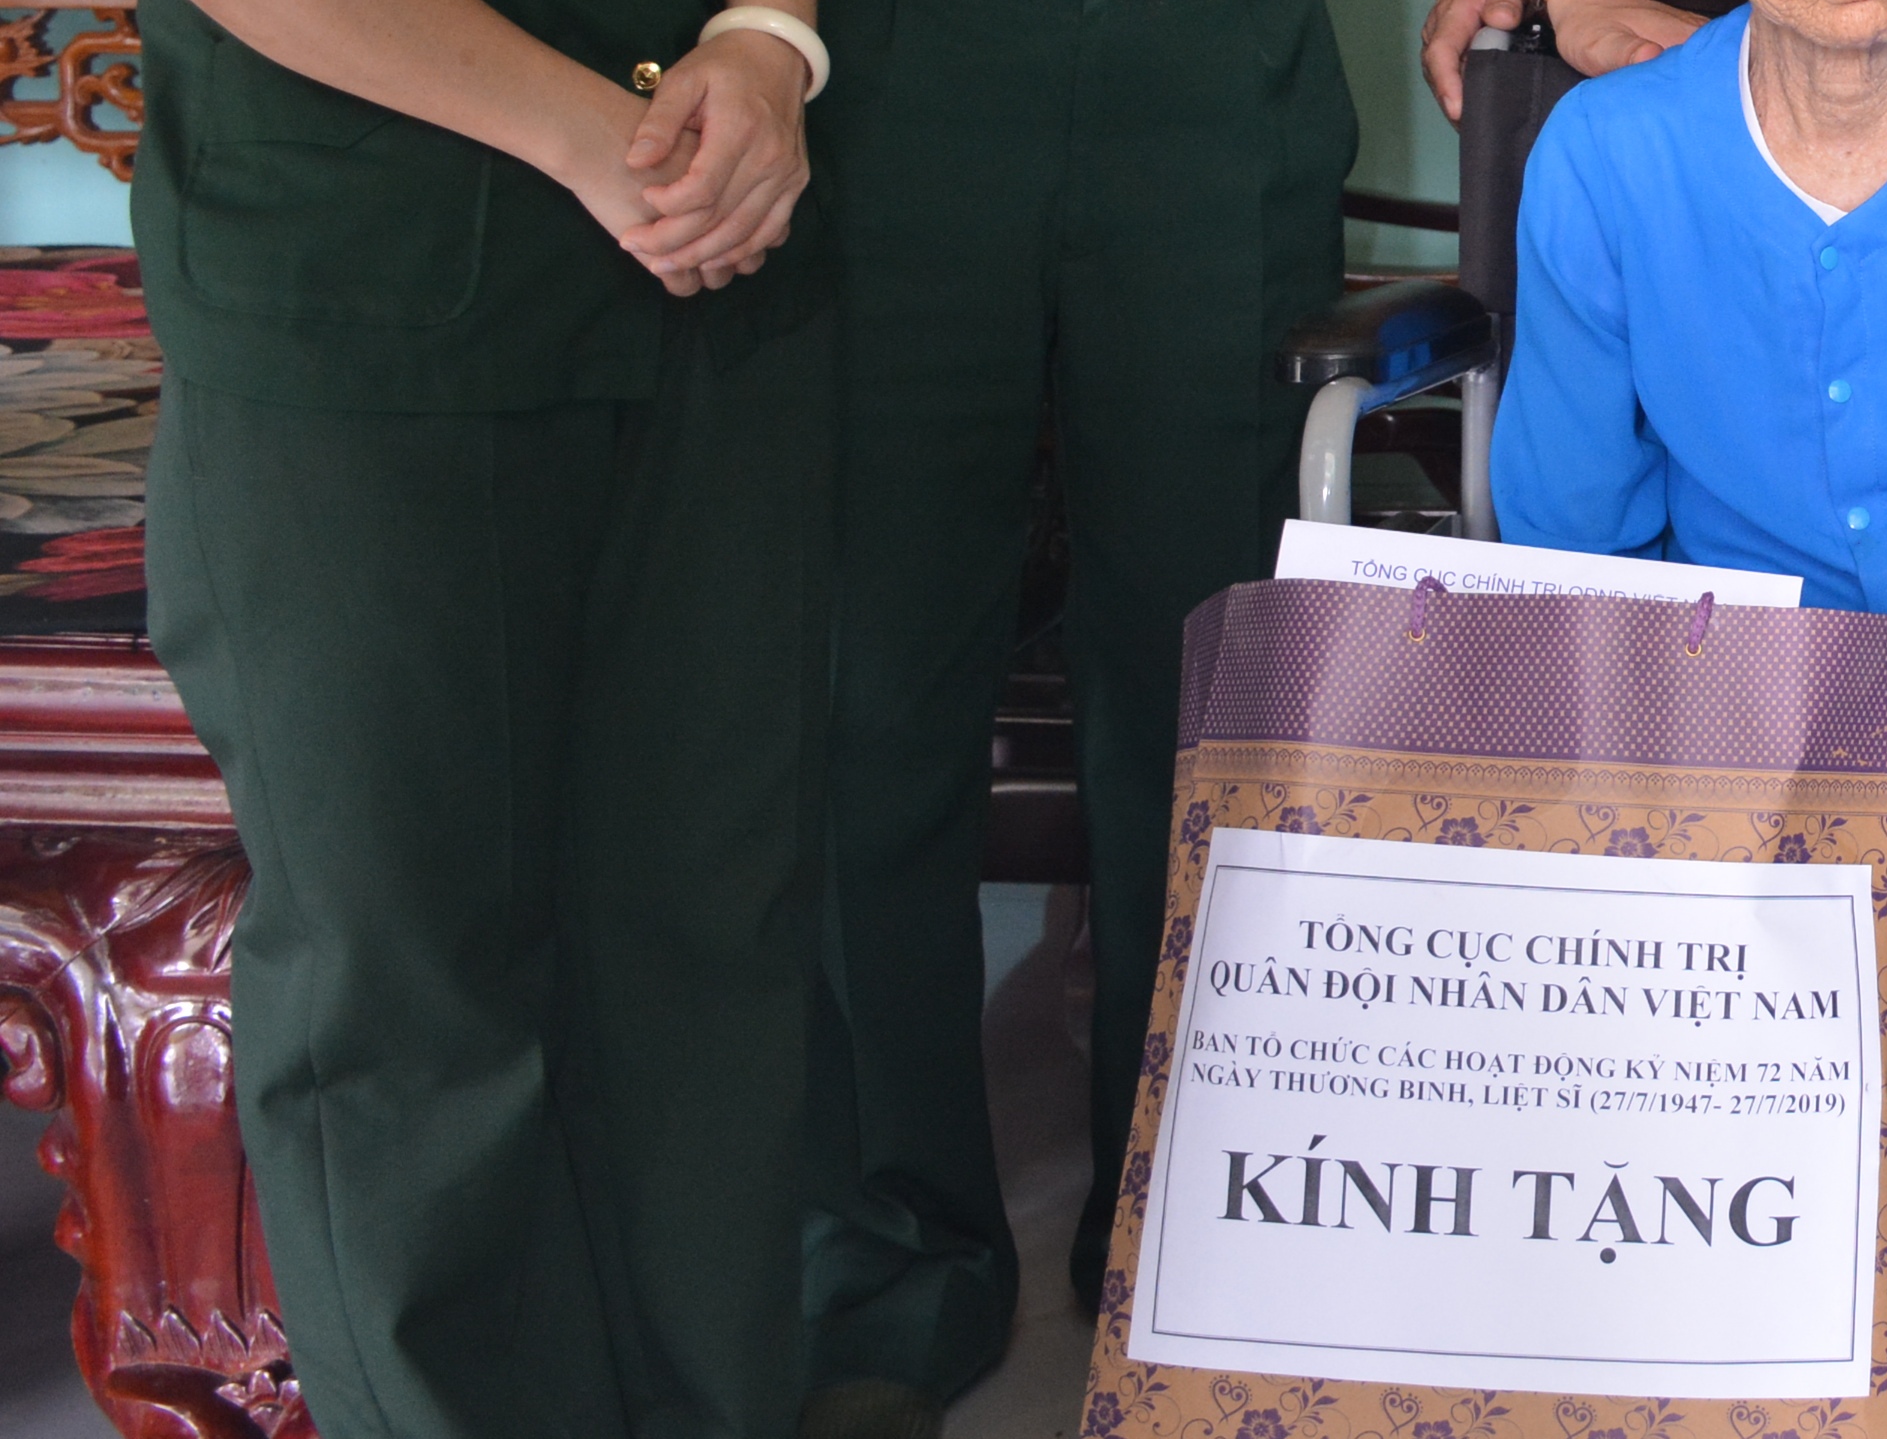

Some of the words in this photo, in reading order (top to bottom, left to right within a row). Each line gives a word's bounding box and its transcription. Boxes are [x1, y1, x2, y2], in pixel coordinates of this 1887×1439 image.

[1351, 559, 1408, 581] TỔNG
[1462, 573, 1525, 594] CHÍNH
[1299, 913, 1414, 956] TỔNG
[1427, 928, 1513, 968] CỤC
[1526, 929, 1663, 969] CHÍNH
[1678, 942, 1749, 981] TRỊ
[1210, 956, 1312, 997] QUÂN
[1323, 967, 1397, 1010] ĐỘI
[1408, 971, 1528, 1011] NHÂN
[1541, 976, 1628, 1016] DÂN
[1641, 985, 1742, 1027] VIỆT
[1752, 989, 1841, 1020] NAM
[1190, 1061, 1262, 1089] NGÀY
[1269, 1070, 1390, 1099] THƯƠNG
[1398, 1079, 1475, 1108] BINH,
[1483, 1083, 1549, 1111] LIỆT
[1556, 1083, 1583, 1109] SĨ
[1590, 1089, 1723, 1115] (27/7/1947-
[1729, 1093, 1846, 1117] 27/7/2019)
[1192, 1030, 1238, 1054] BAN
[1246, 1031, 1282, 1058] TỔ
[1290, 1037, 1370, 1064] CHỨC
[1378, 1041, 1437, 1069] CÁC
[1445, 1050, 1526, 1078] HOẠT
[1533, 1053, 1616, 1081] ĐỘNG
[1625, 1053, 1666, 1080] KỶ
[1674, 1059, 1748, 1087] NIỆM
[1757, 1063, 1782, 1083] 72
[1790, 1056, 1850, 1082] NĂM
[1217, 1134, 1483, 1237] KÍNH
[1511, 1160, 1800, 1264] TẶNG
